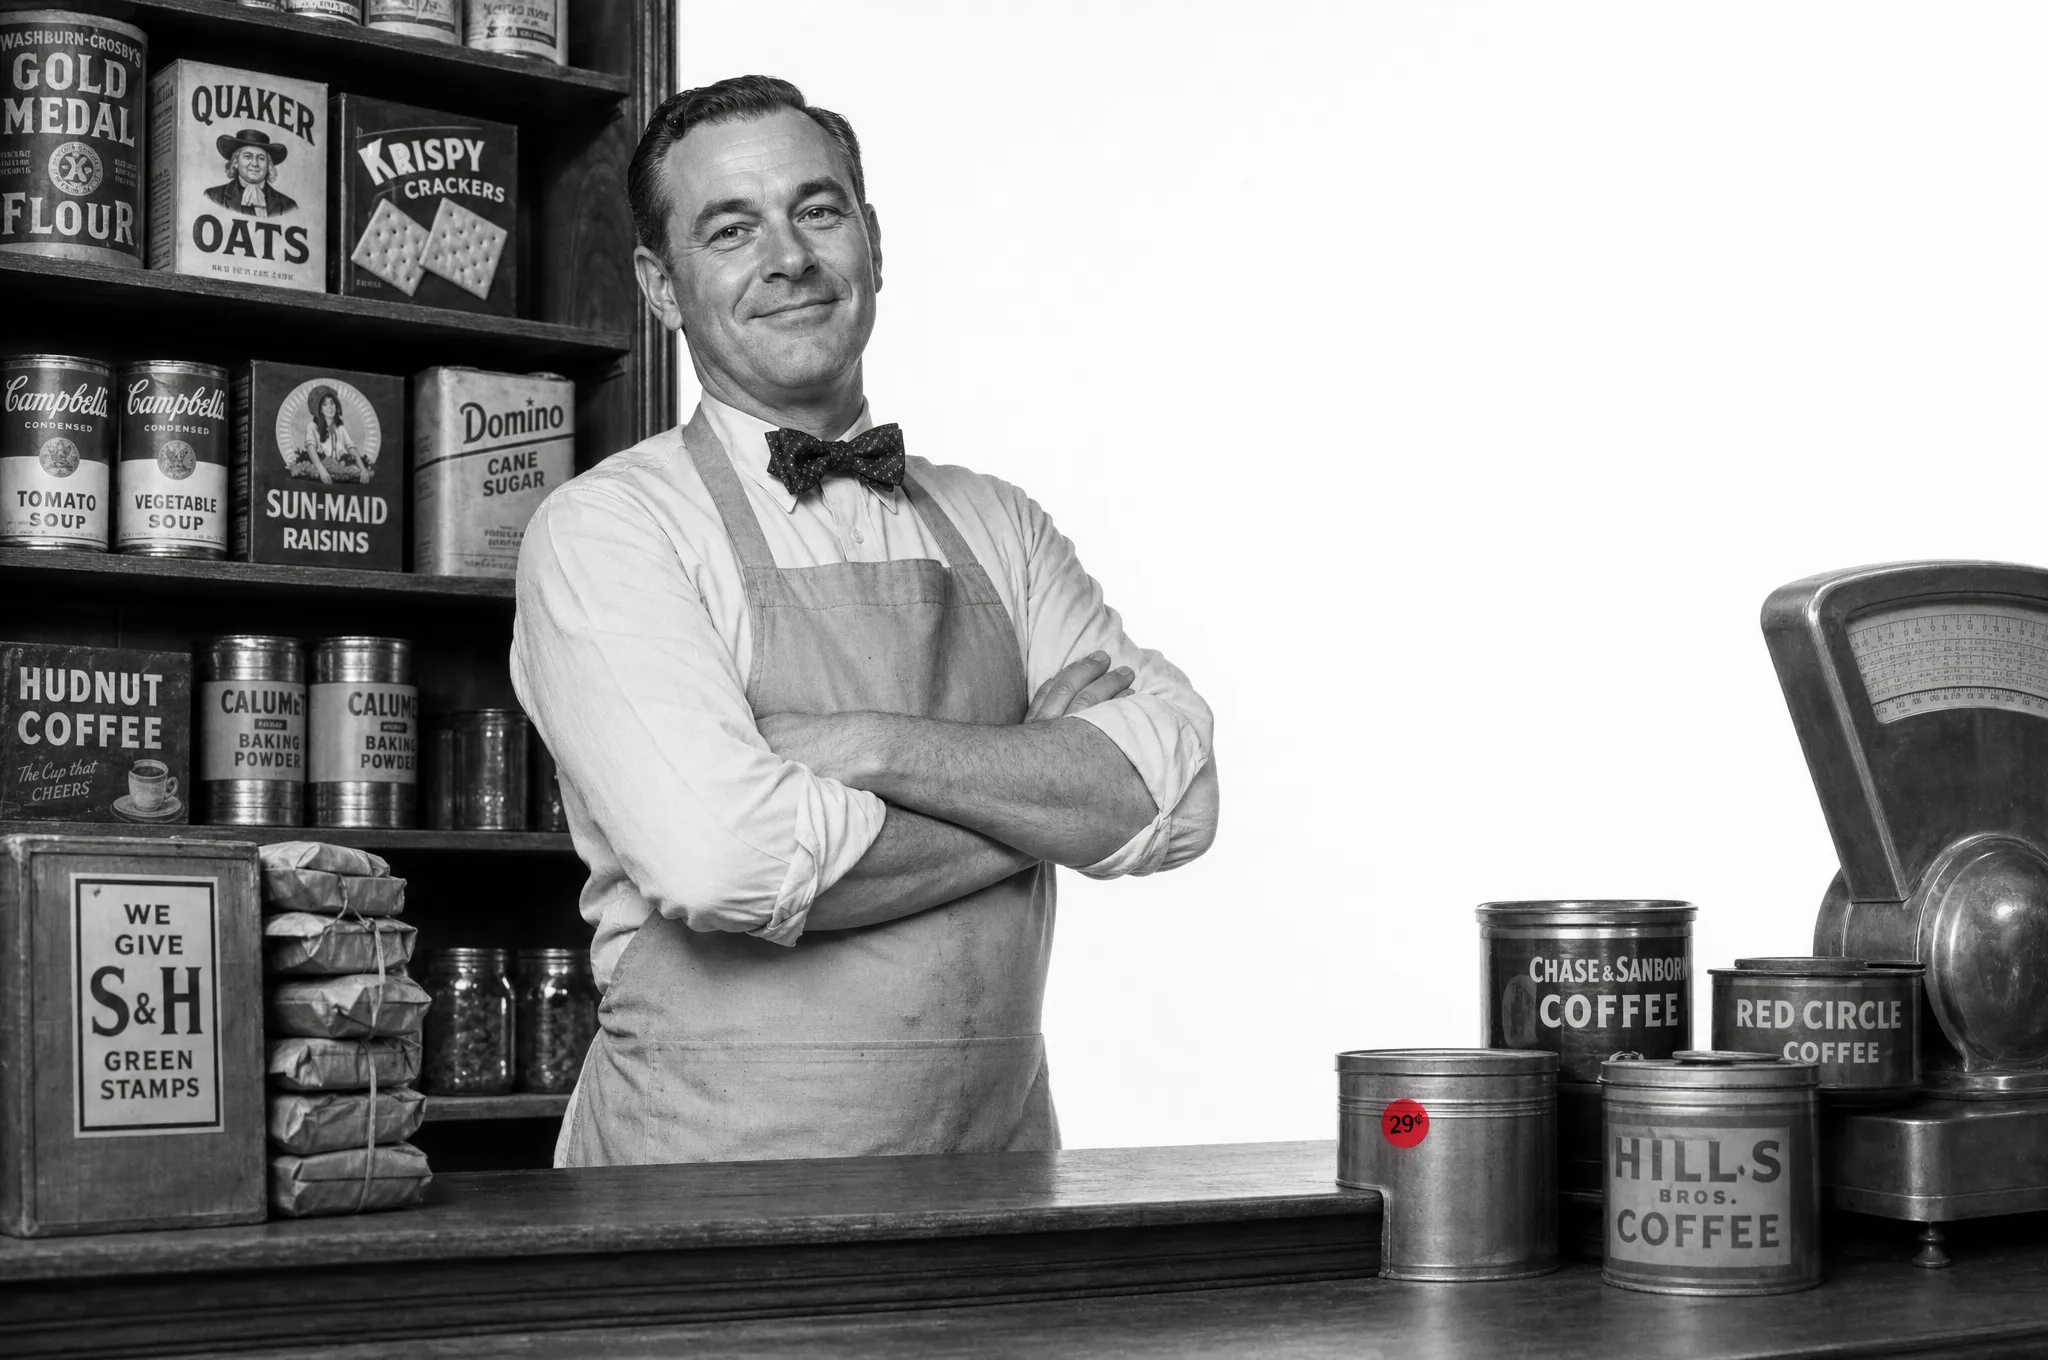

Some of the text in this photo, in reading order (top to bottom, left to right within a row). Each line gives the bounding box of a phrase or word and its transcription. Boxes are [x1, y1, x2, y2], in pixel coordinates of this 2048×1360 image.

[0, 30, 142, 68] WASHBURN-CROSBY'S
[13, 52, 127, 99] GOLD
[2, 97, 135, 148] MEDAL
[191, 84, 316, 147] QUAKER
[357, 137, 485, 187] KRISPY
[404, 177, 506, 204] CRACKERS
[2, 192, 135, 247] FLOUR
[192, 214, 310, 265] OATS
[5, 375, 108, 419] Campbell's
[127, 379, 226, 422] Campbell's
[24, 421, 93, 433] CONDENSED
[144, 424, 210, 435] CONDENSED
[459, 397, 565, 445] Domino
[487, 451, 538, 476] CANE
[483, 470, 545, 497] SUGAR
[17, 490, 97, 511] TOMATO
[135, 494, 217, 514] VEGETABLE
[266, 488, 388, 525] SUN-MAID
[29, 512, 86, 529] SOUP
[148, 515, 204, 530] SOUP
[283, 527, 370, 554] RAISINS
[19, 666, 163, 707] HUDNUT
[18, 711, 162, 750] COFFEE
[239, 733, 300, 750] BAKING
[18, 759, 99, 784] The Cup that
[235, 751, 301, 768] POWDER
[123, 903, 171, 925] WE
[115, 934, 183, 955] GIVE
[1529, 956, 1599, 983] CHASE
[1616, 955, 1689, 983] SANBORN
[1540, 993, 1678, 1029] COFFEE
[1736, 999, 1902, 1030] RED CIRCLE
[104, 1050, 193, 1071] GREEN
[1783, 1041, 1879, 1064] COFFEE
[100, 1078, 200, 1100] STAMPS
[1390, 1113, 1423, 1134] 29¢
[1659, 1188, 1737, 1205] BROS.
[1617, 1208, 1780, 1249] COFFEE
